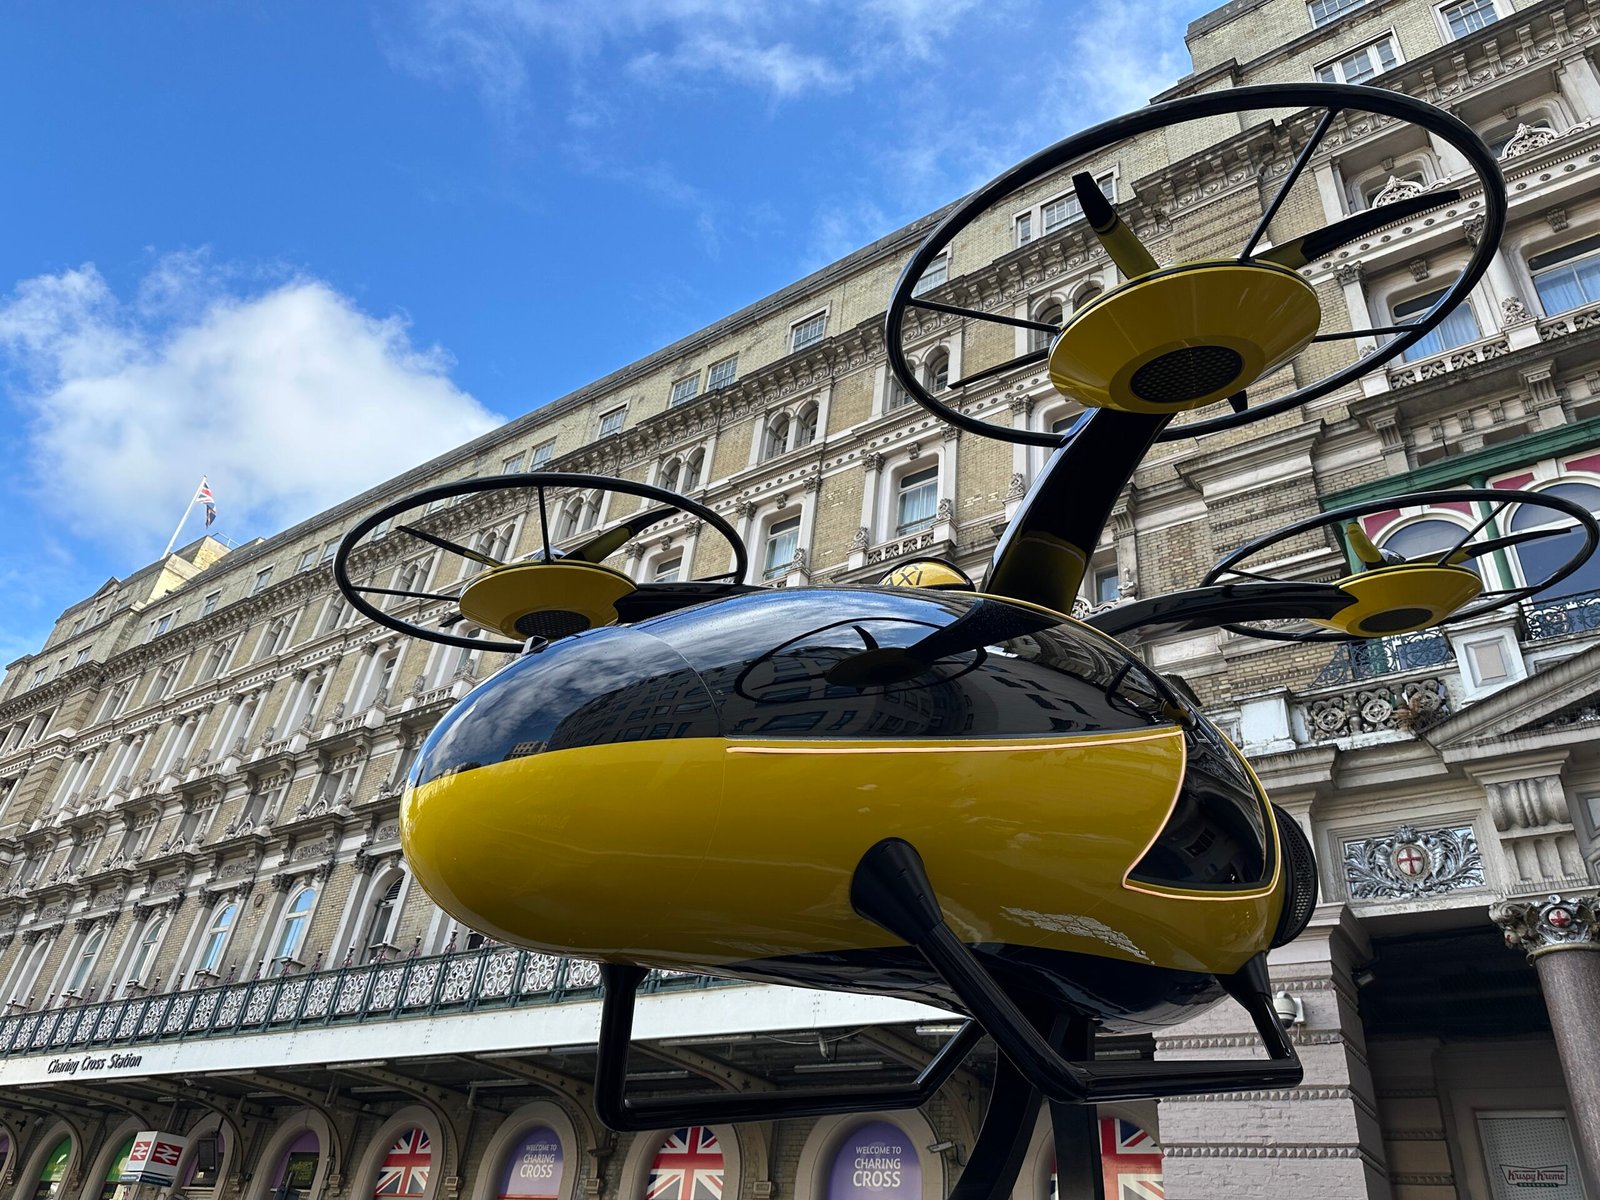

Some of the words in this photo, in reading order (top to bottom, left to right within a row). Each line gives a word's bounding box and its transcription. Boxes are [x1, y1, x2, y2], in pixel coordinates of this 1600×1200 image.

[47, 1058, 80, 1075] Charing
[81, 1055, 107, 1072] Cross
[107, 1053, 143, 1069] Station
[855, 1146, 891, 1154] WELCOME
[892, 1146, 902, 1154] TO
[523, 1153, 556, 1163] CHARING
[854, 1158, 901, 1169] CHARING
[520, 1164, 554, 1178] CROSS
[1507, 1169, 1537, 1182] Krispy
[1536, 1169, 1565, 1181] Kreme
[853, 1170, 901, 1187] CROSS
